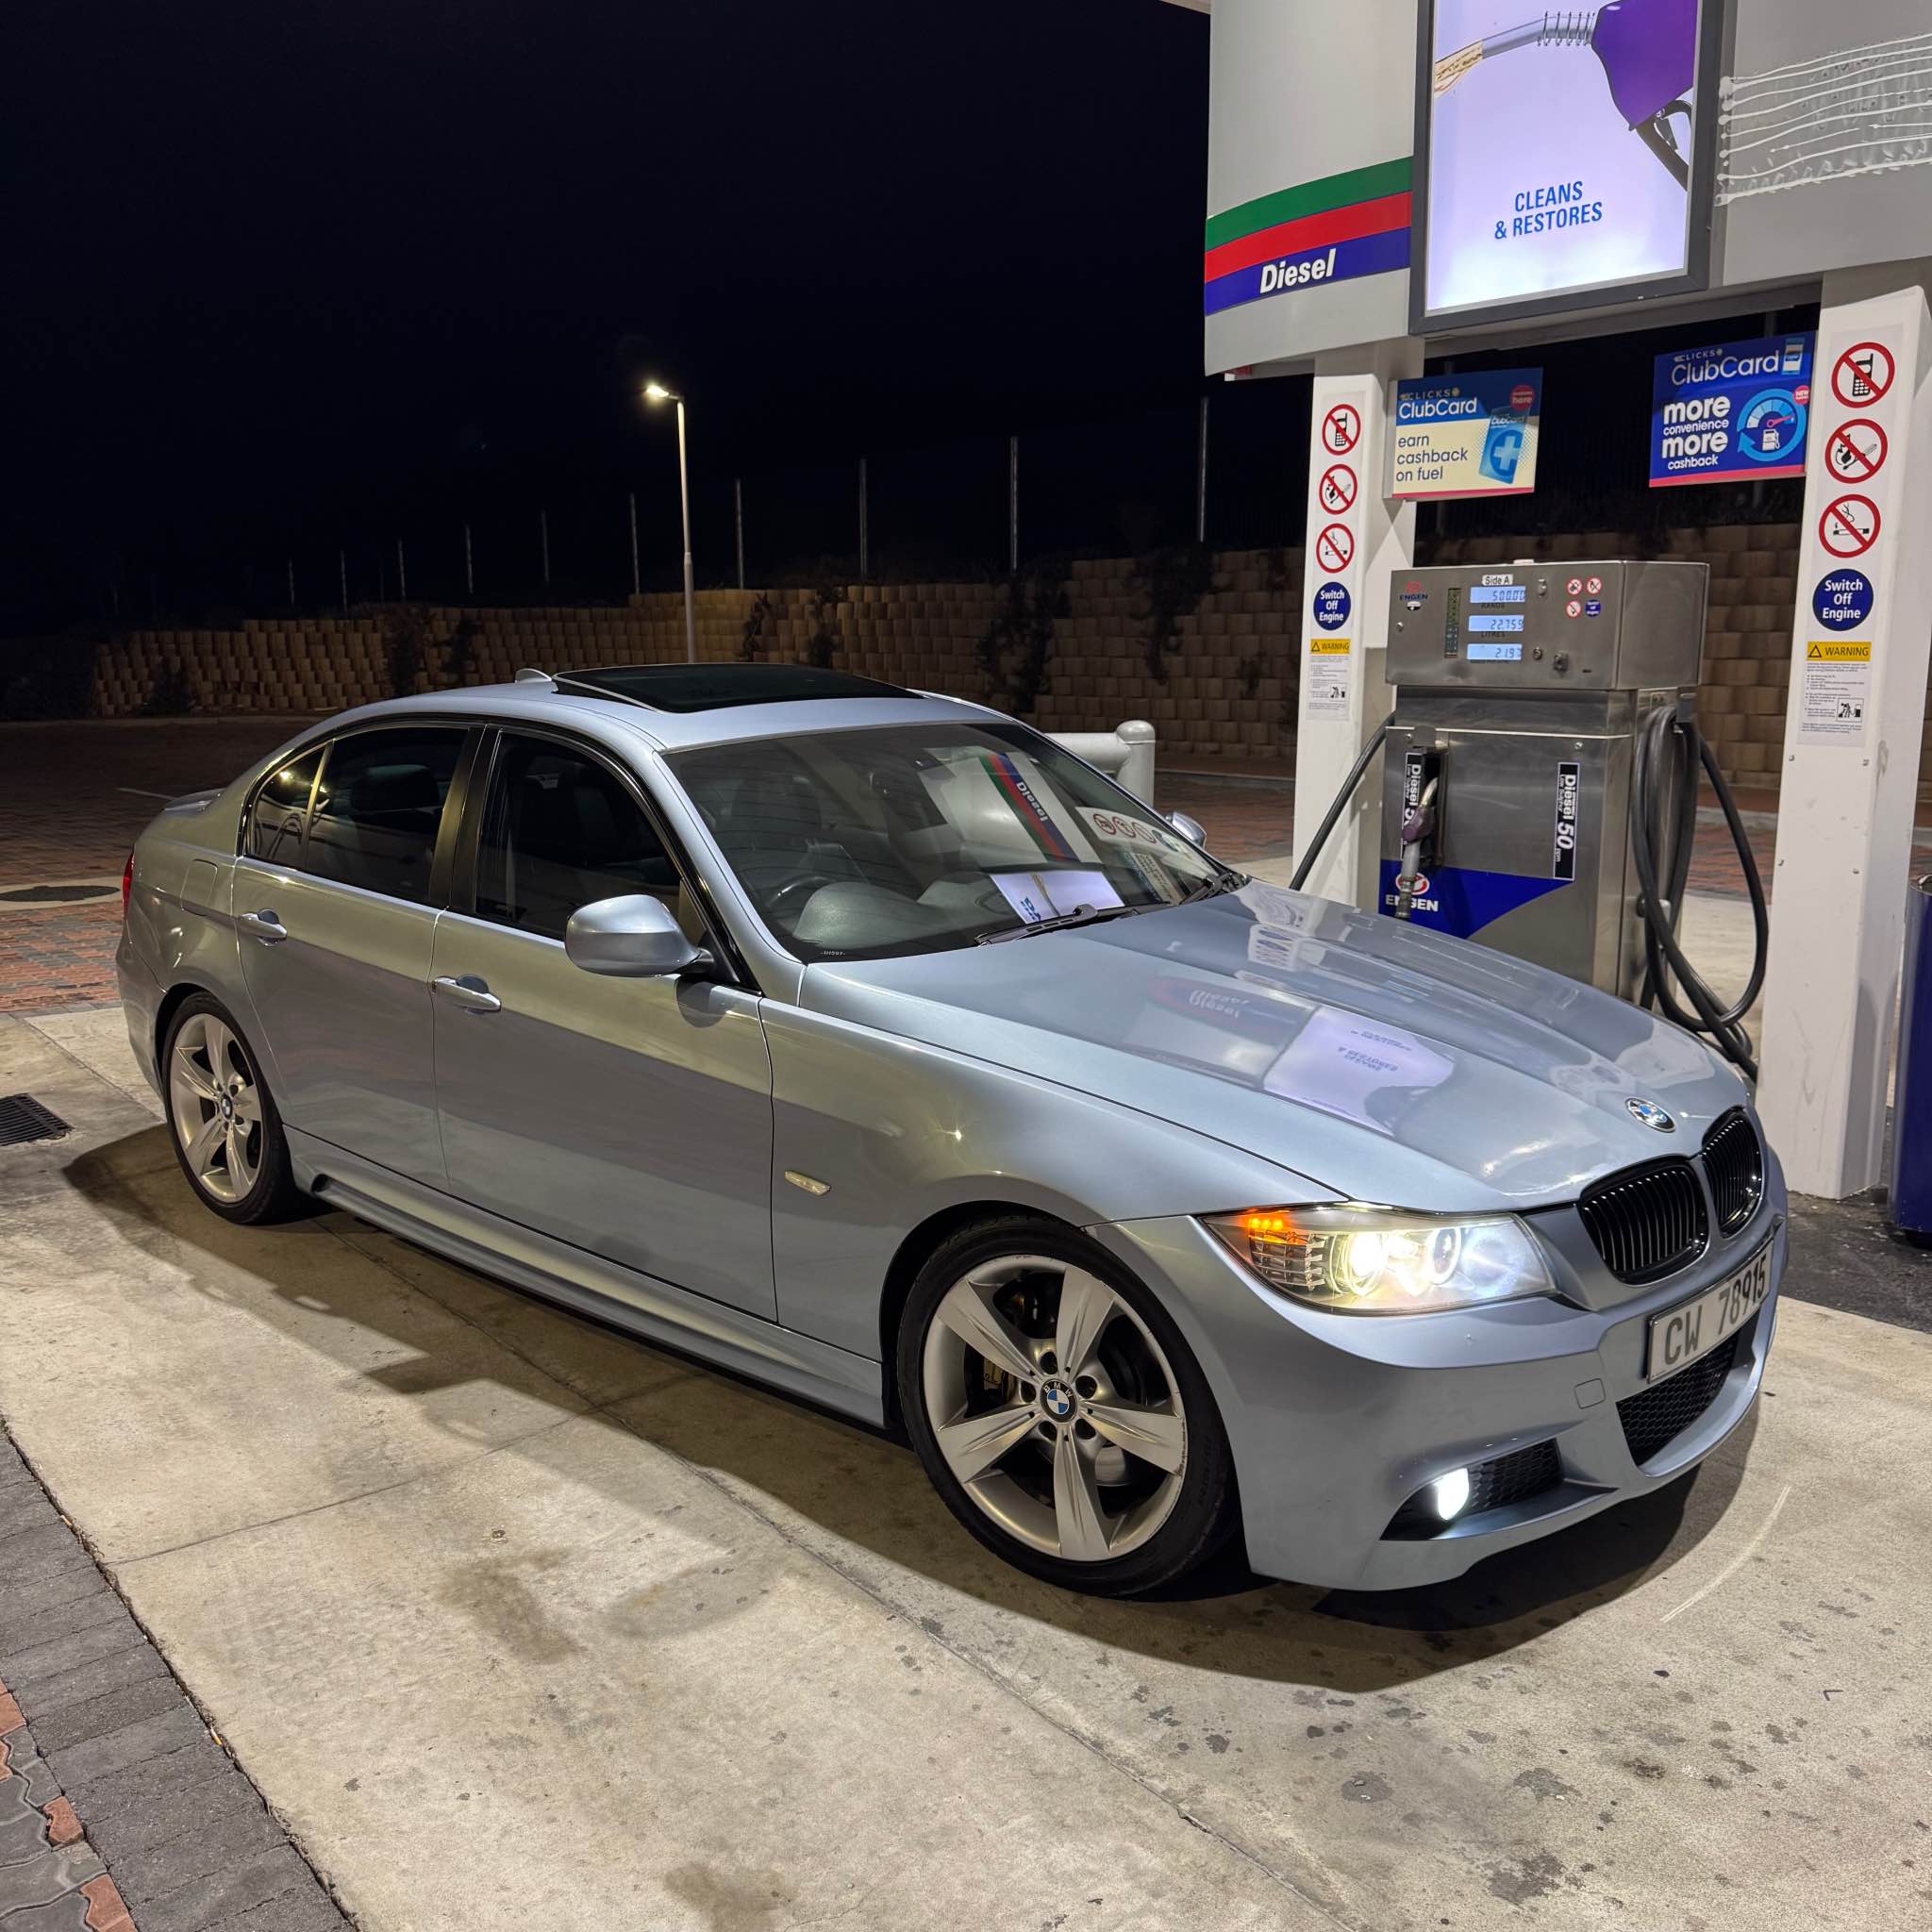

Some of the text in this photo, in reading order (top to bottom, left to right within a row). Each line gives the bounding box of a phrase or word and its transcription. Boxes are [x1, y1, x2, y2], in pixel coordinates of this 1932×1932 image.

[1514, 180, 1583, 212] CLEANS
[1494, 201, 1604, 240] & RESTORES
[1259, 248, 1337, 294] Diesel
[1672, 350, 1779, 386] ClubCard
[1408, 389, 1452, 401] CLICKS
[1399, 397, 1477, 419] ClubCard
[1663, 396, 1731, 425] more
[1663, 419, 1730, 437] convenience
[1398, 435, 1429, 448] earn
[1662, 431, 1728, 459] more
[1397, 447, 1469, 465] cashback
[1667, 455, 1719, 471] cashback
[1396, 466, 1443, 482] on fuel
[1485, 575, 1510, 585] Side A
[1824, 579, 1863, 592] Switch
[1321, 590, 1345, 600] Switch
[1833, 592, 1853, 606] Off
[1325, 600, 1339, 610] Off
[1319, 612, 1344, 624] Engine
[1823, 608, 1861, 622] Engine
[1321, 641, 1350, 650] WARNING
[1824, 646, 1870, 657] WARNING
[1409, 764, 1422, 807] Diesel
[1557, 774, 1576, 850] Diesel 50
[1664, 1253, 1767, 1365] CW 78915
[1043, 1381, 1074, 1398] BMW
